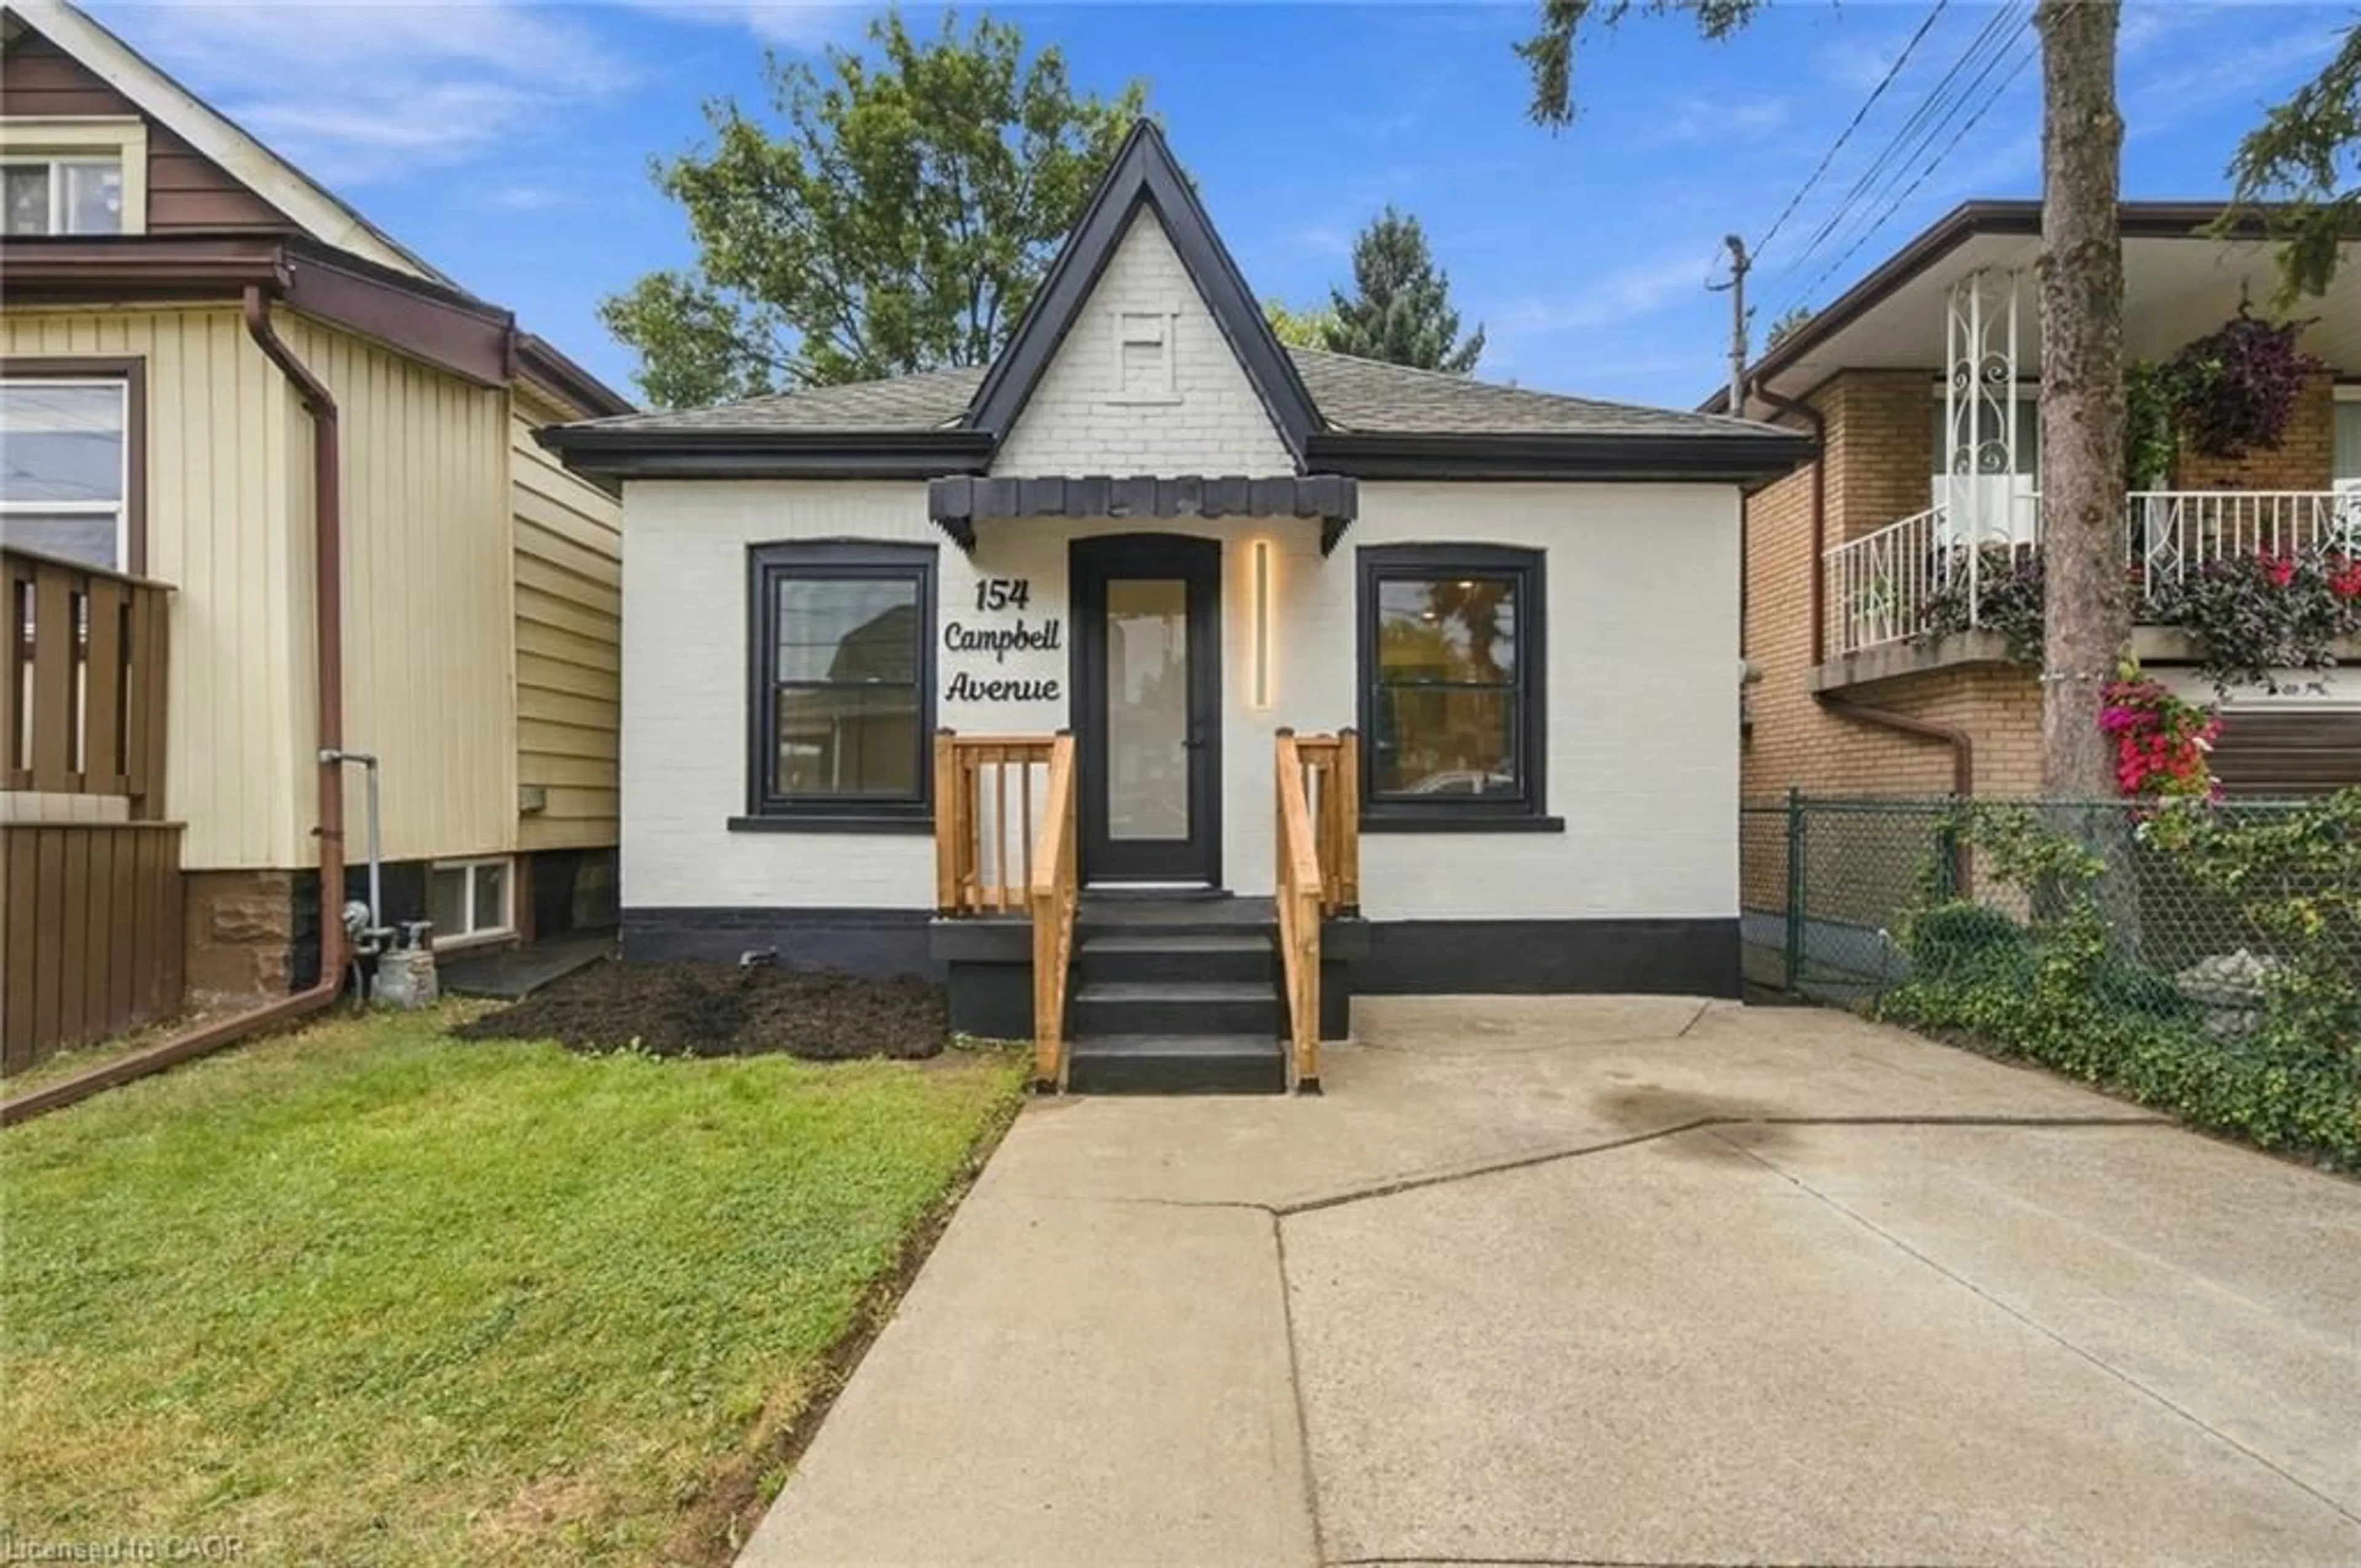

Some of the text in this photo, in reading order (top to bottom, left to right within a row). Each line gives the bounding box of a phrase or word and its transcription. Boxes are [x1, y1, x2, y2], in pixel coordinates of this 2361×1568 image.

[976, 578, 1030, 611] 154
[945, 619, 1061, 662] Campbell
[945, 672, 1060, 700] Avenue
